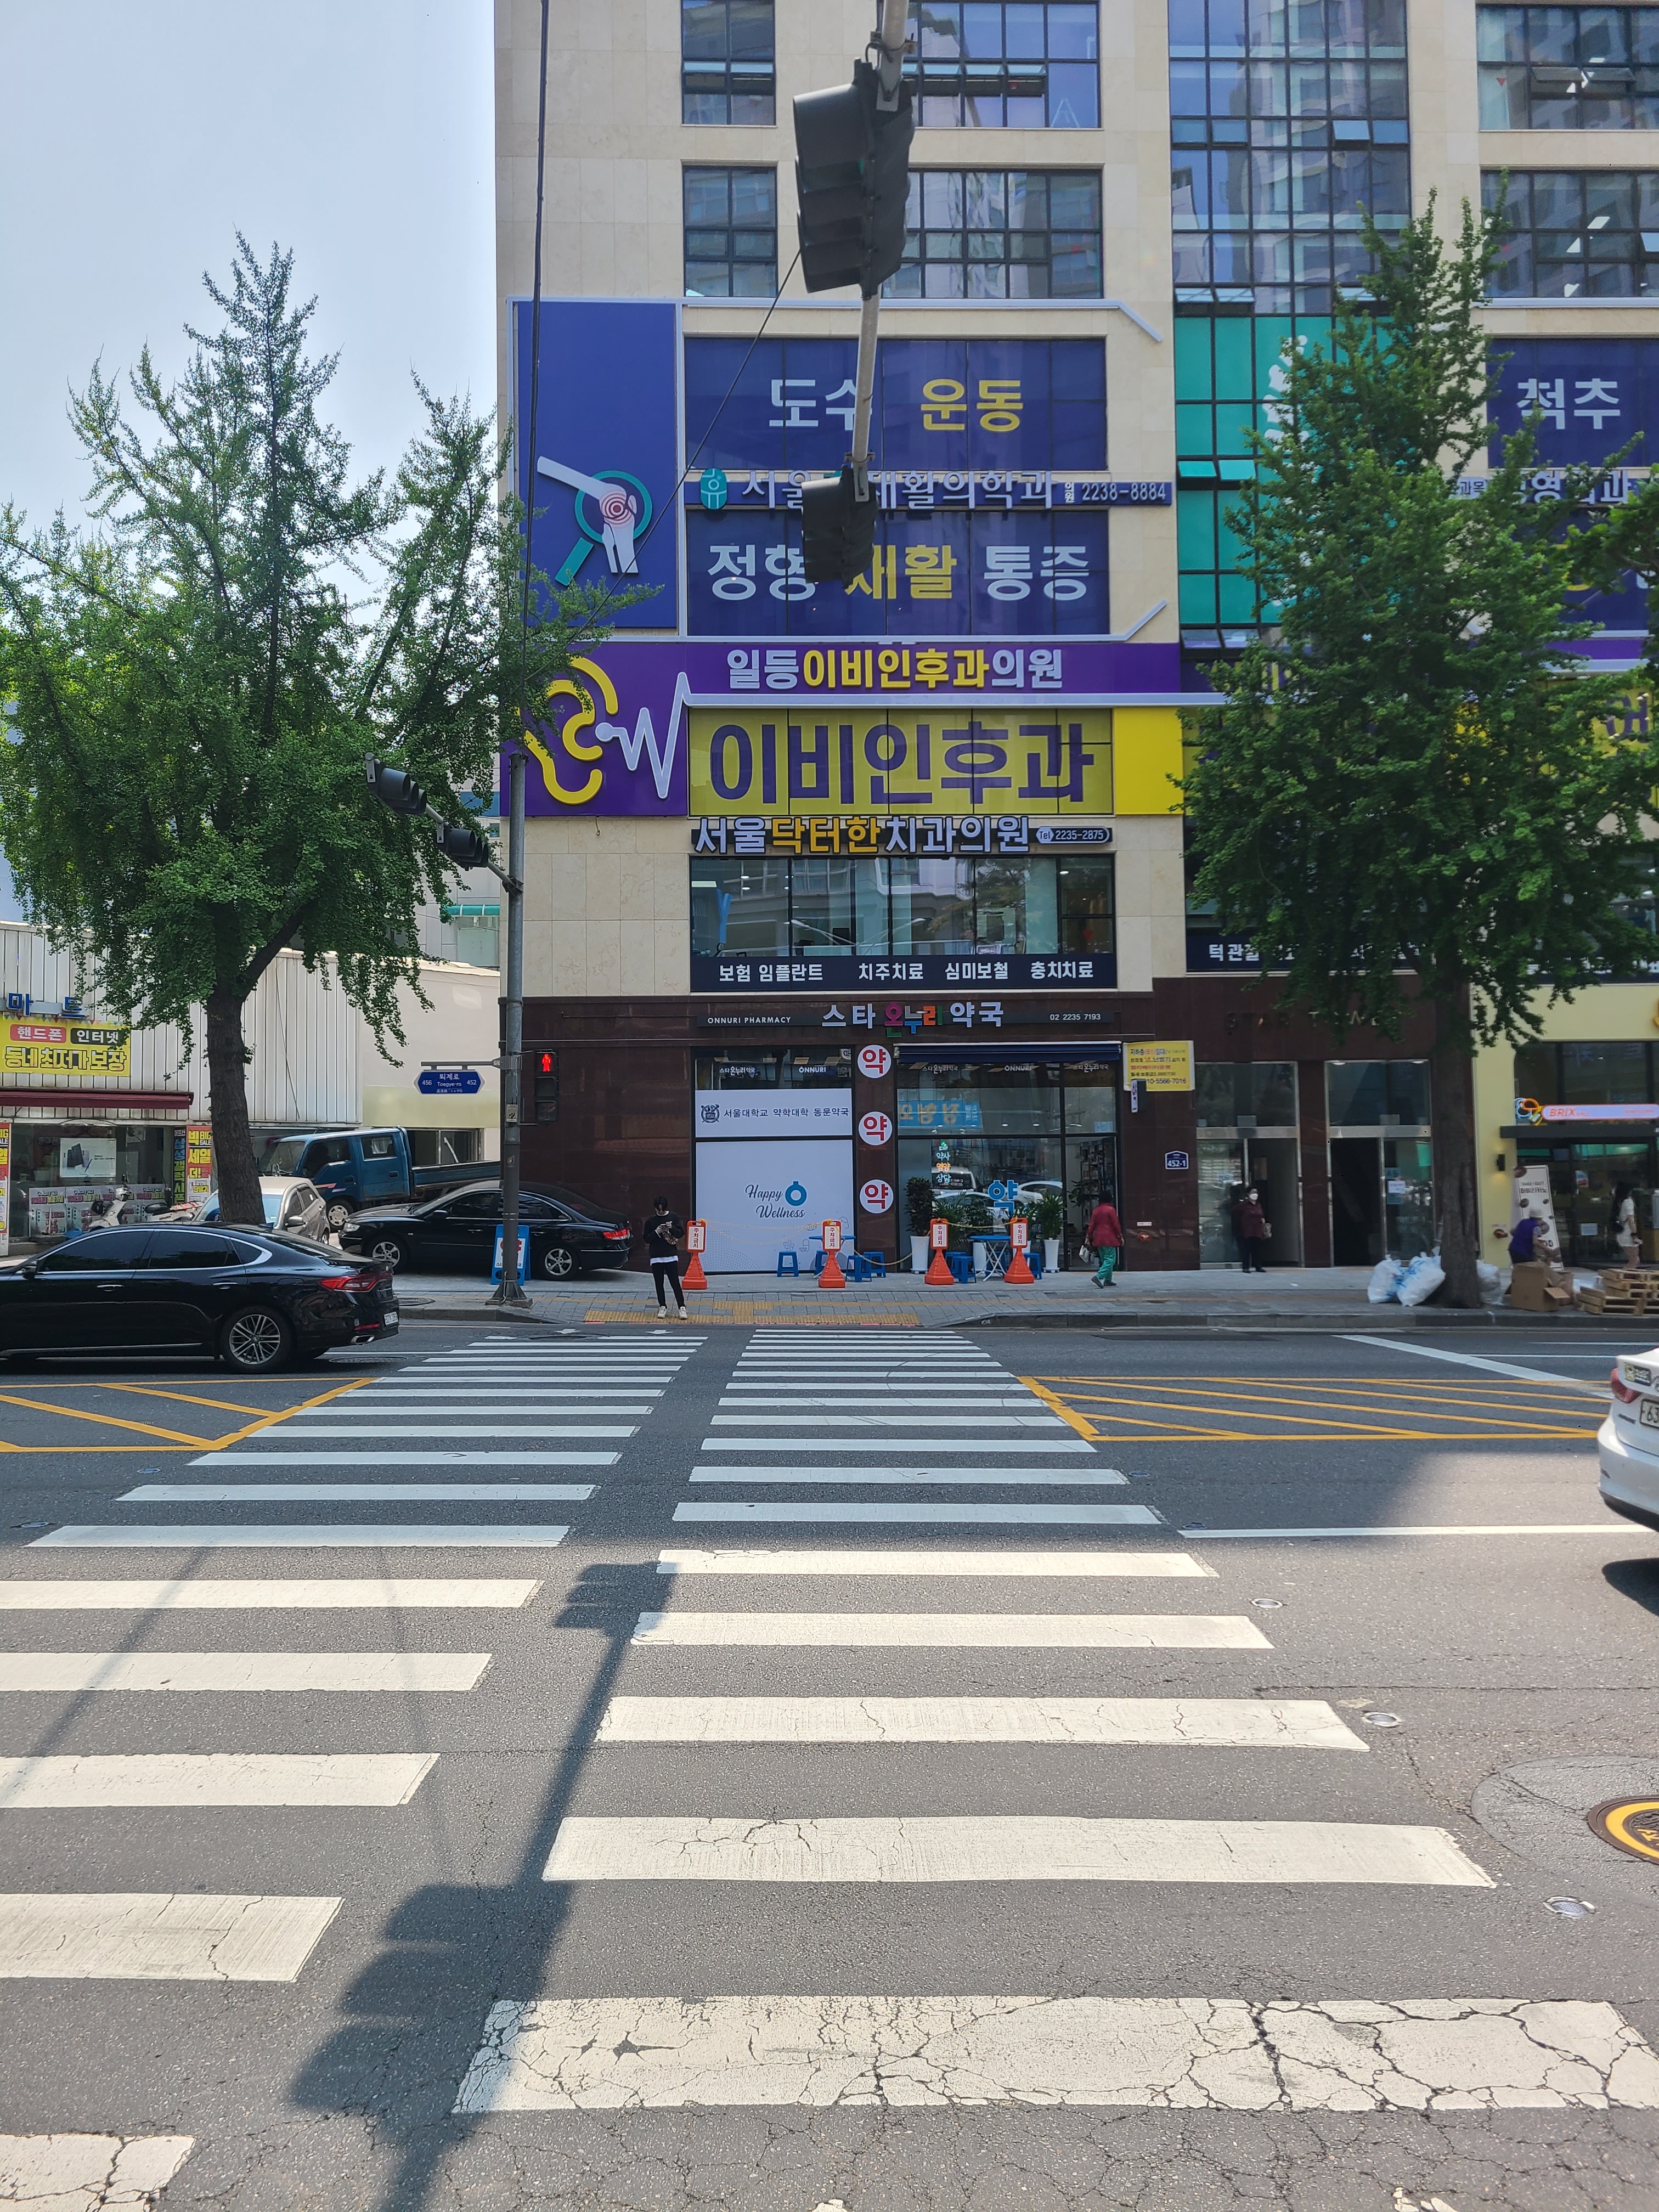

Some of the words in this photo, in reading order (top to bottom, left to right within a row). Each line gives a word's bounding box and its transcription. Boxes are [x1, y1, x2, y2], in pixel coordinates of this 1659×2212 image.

[769, 379, 872, 431] 도수
[920, 379, 1023, 432] 운동
[1516, 377, 1621, 431] 척추
[742, 470, 1058, 509] 서울재활의학과
[1081, 482, 1166, 502] 2238-8884
[708, 544, 816, 601] 정형
[984, 545, 1090, 601] 통증
[727, 649, 1063, 690] 일등이비인후과의원
[709, 720, 1095, 805] 이비인후과
[695, 816, 1029, 854] 서울닥터한치과의원
[1039, 831, 1051, 840] Tel
[1055, 830, 1104, 840] 2235-2875
[1209, 944, 1260, 962] 턱관절
[719, 964, 751, 982] 보험
[759, 964, 823, 982] 임플란트
[859, 963, 924, 980] 치주치료
[945, 962, 1008, 980] 심미보철
[1030, 961, 1094, 979] 충치치료
[7, 992, 87, 1019] 마트
[1084, 1013, 1101, 1021] 7193
[822, 1003, 876, 1029] 스타
[884, 1001, 943, 1038] 온누리
[950, 1002, 1004, 1028] 약국
[17, 1026, 63, 1041] 핸드폰
[76, 1029, 119, 1044] 인터넷
[5, 1046, 39, 1068] 동네
[40, 1047, 89, 1070] 최저가
[90, 1050, 127, 1071] 보장
[798, 1065, 827, 1074] ONNURI
[862, 1048, 887, 1074] 약
[723, 1108, 768, 1118] 서울대학교
[772, 1108, 809, 1117] 약학대학
[813, 1107, 849, 1117] 동문약국
[1549, 1108, 1577, 1117] BRIX
[200, 1131, 212, 1140] BIG
[863, 1116, 888, 1142] 약
[188, 1148, 211, 1164] 세일
[936, 1152, 951, 1161] 약사
[936, 1162, 951, 1172] 영양
[936, 1173, 952, 1184] 상담
[744, 1184, 783, 1201] Happy
[865, 1183, 889, 1209] 약
[988, 1180, 1019, 1216] 약
[755, 1204, 805, 1218] Wellness
